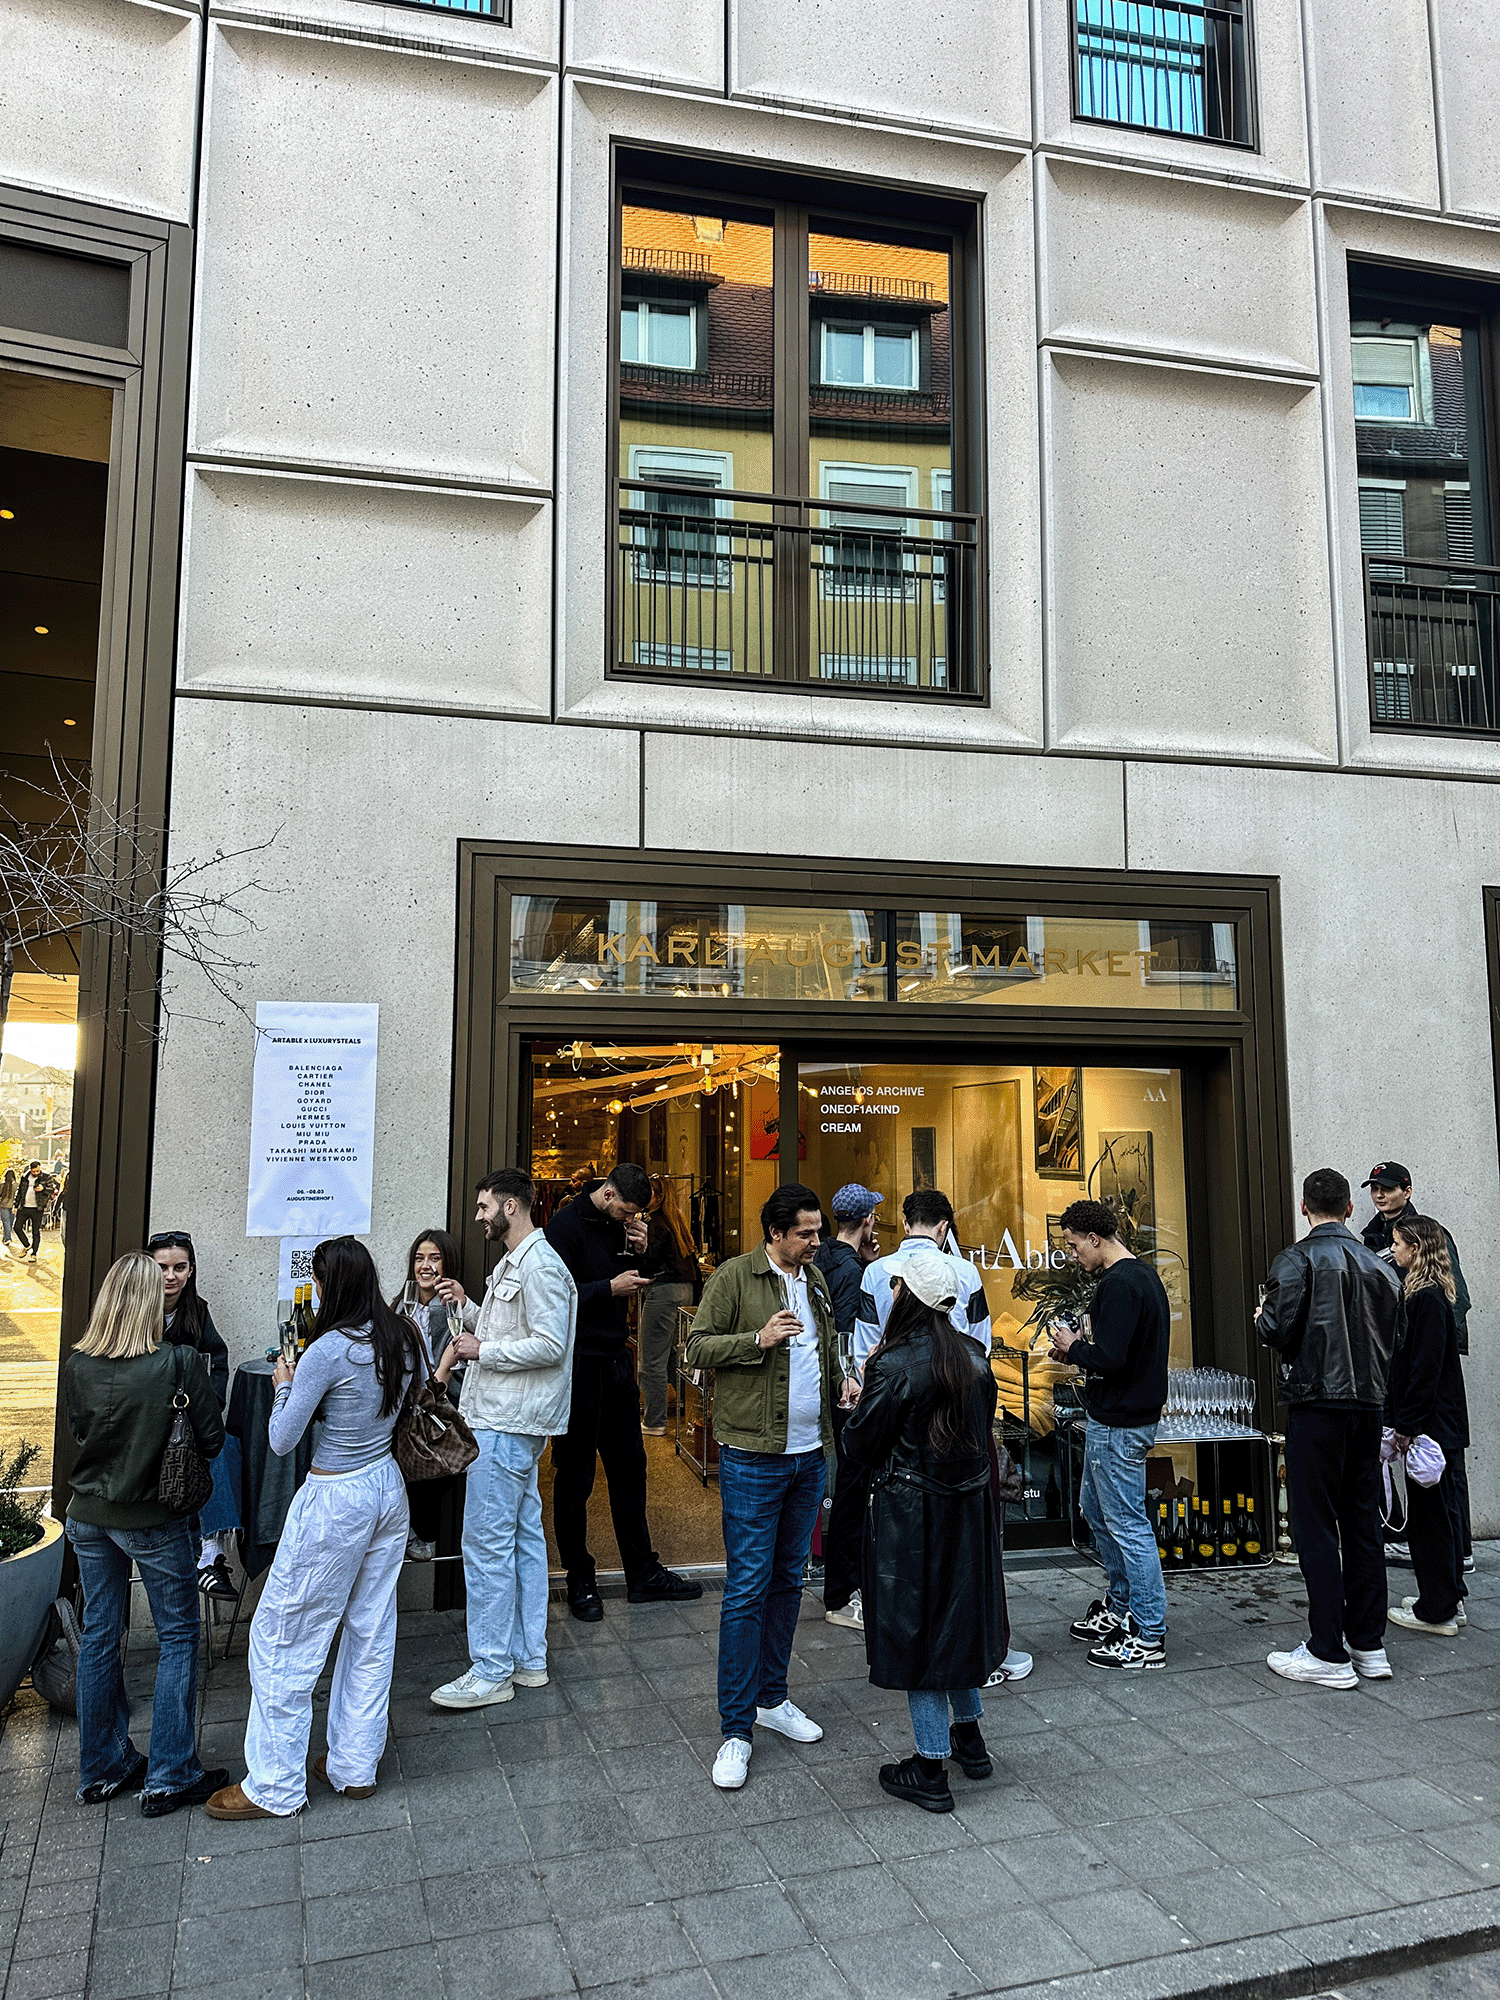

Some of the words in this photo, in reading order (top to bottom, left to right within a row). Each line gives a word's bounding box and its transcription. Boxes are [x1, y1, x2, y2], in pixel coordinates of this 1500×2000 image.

[597, 932, 728, 966] KARL
[747, 937, 951, 970] AUGUST
[970, 944, 1159, 977] MARKET
[820, 1085, 874, 1096] ANGELOS
[876, 1086, 925, 1097] ARCHIVE
[1143, 1087, 1167, 1102] AA
[820, 1104, 901, 1115] ONEOF1AKIND
[820, 1122, 862, 1133] CREAM
[941, 1227, 1066, 1270] ArtAble
